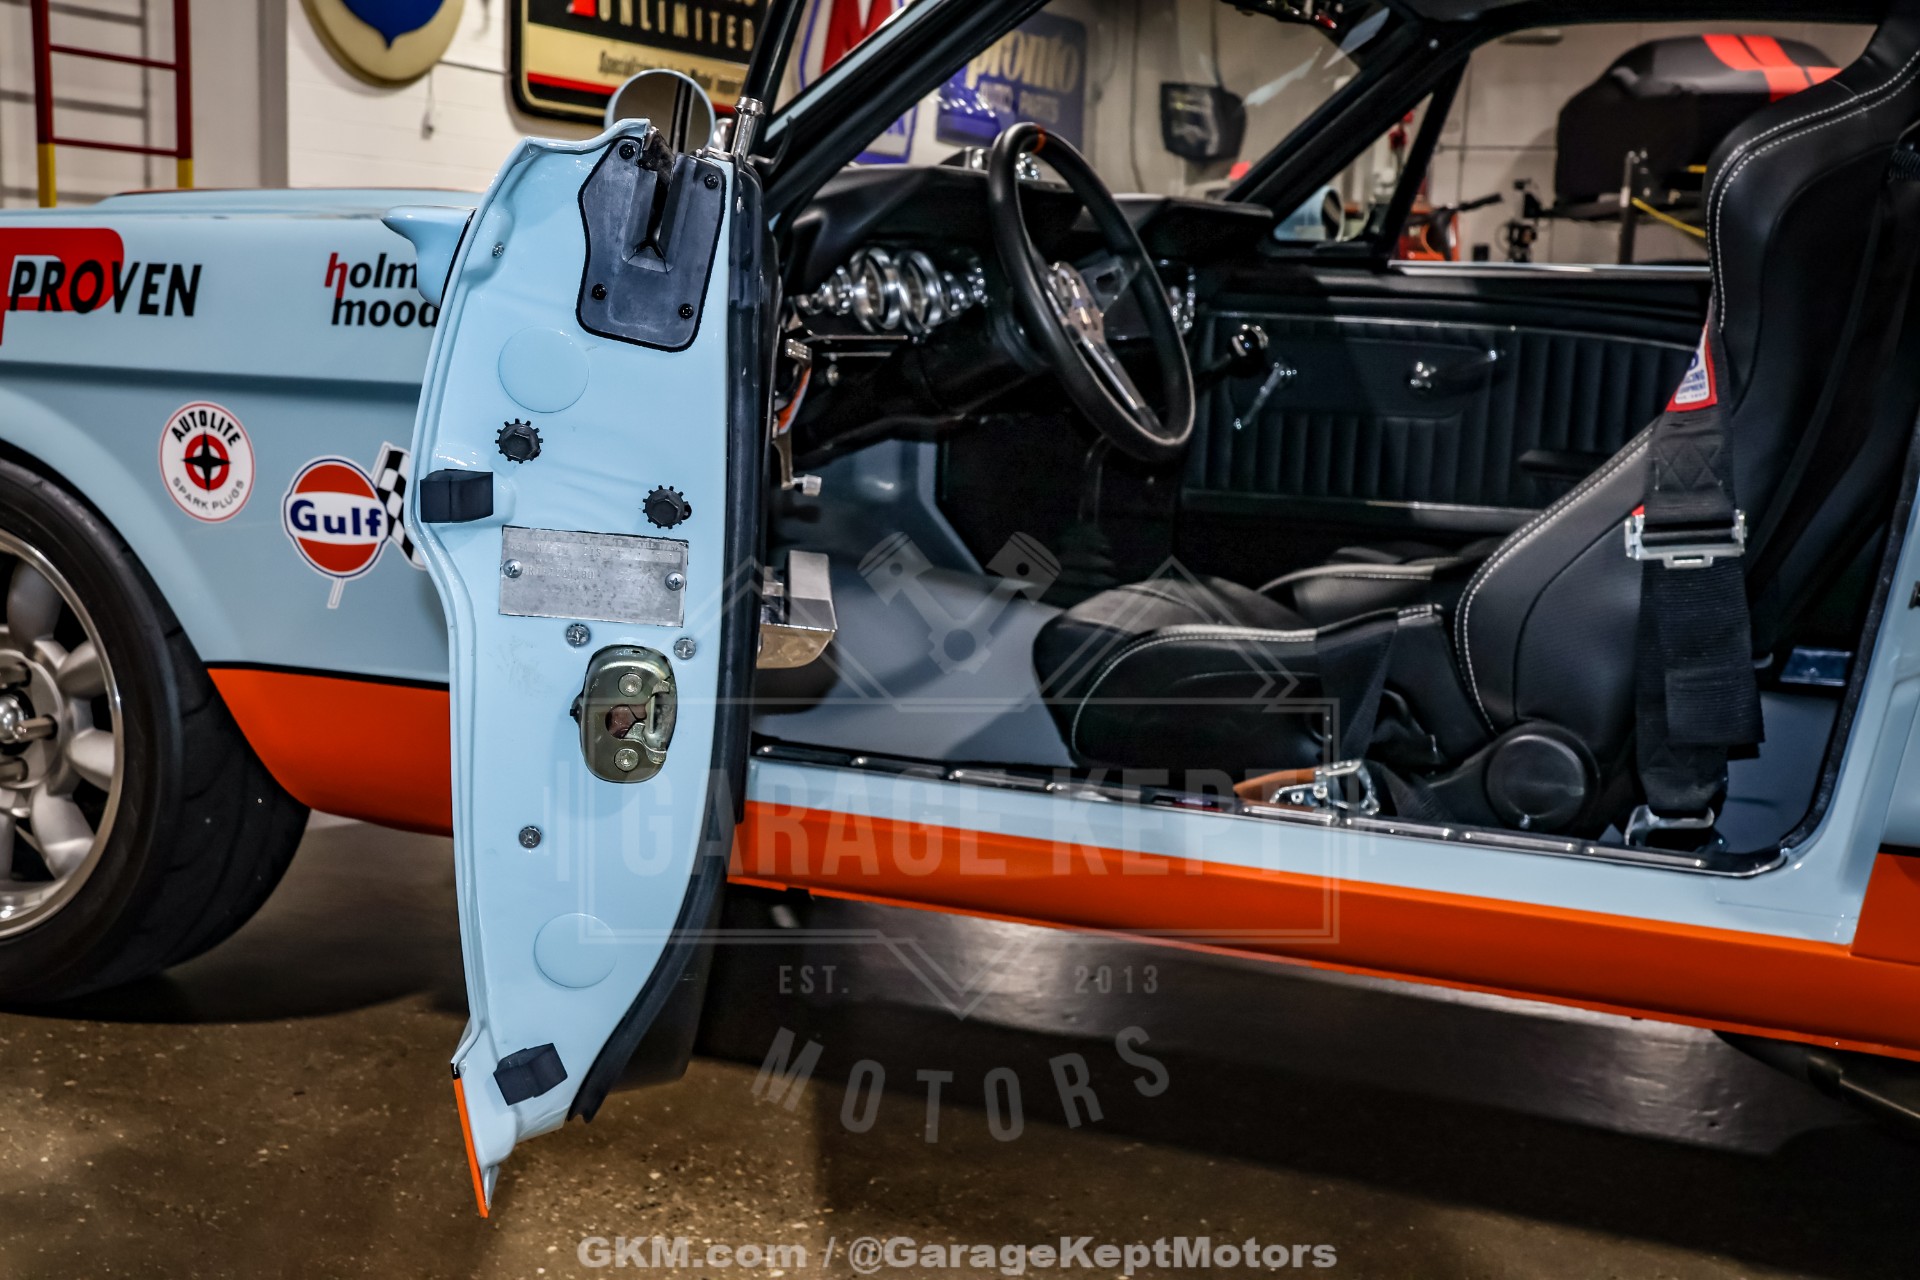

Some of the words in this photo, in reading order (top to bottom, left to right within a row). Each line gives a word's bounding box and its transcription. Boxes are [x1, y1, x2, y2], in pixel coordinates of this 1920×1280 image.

[9, 259, 203, 317] PROVEN
[171, 409, 241, 447] AUTOLITE
[173, 477, 208, 510] SPARK
[212, 480, 244, 509] PLUGS
[290, 500, 382, 536] Gulf
